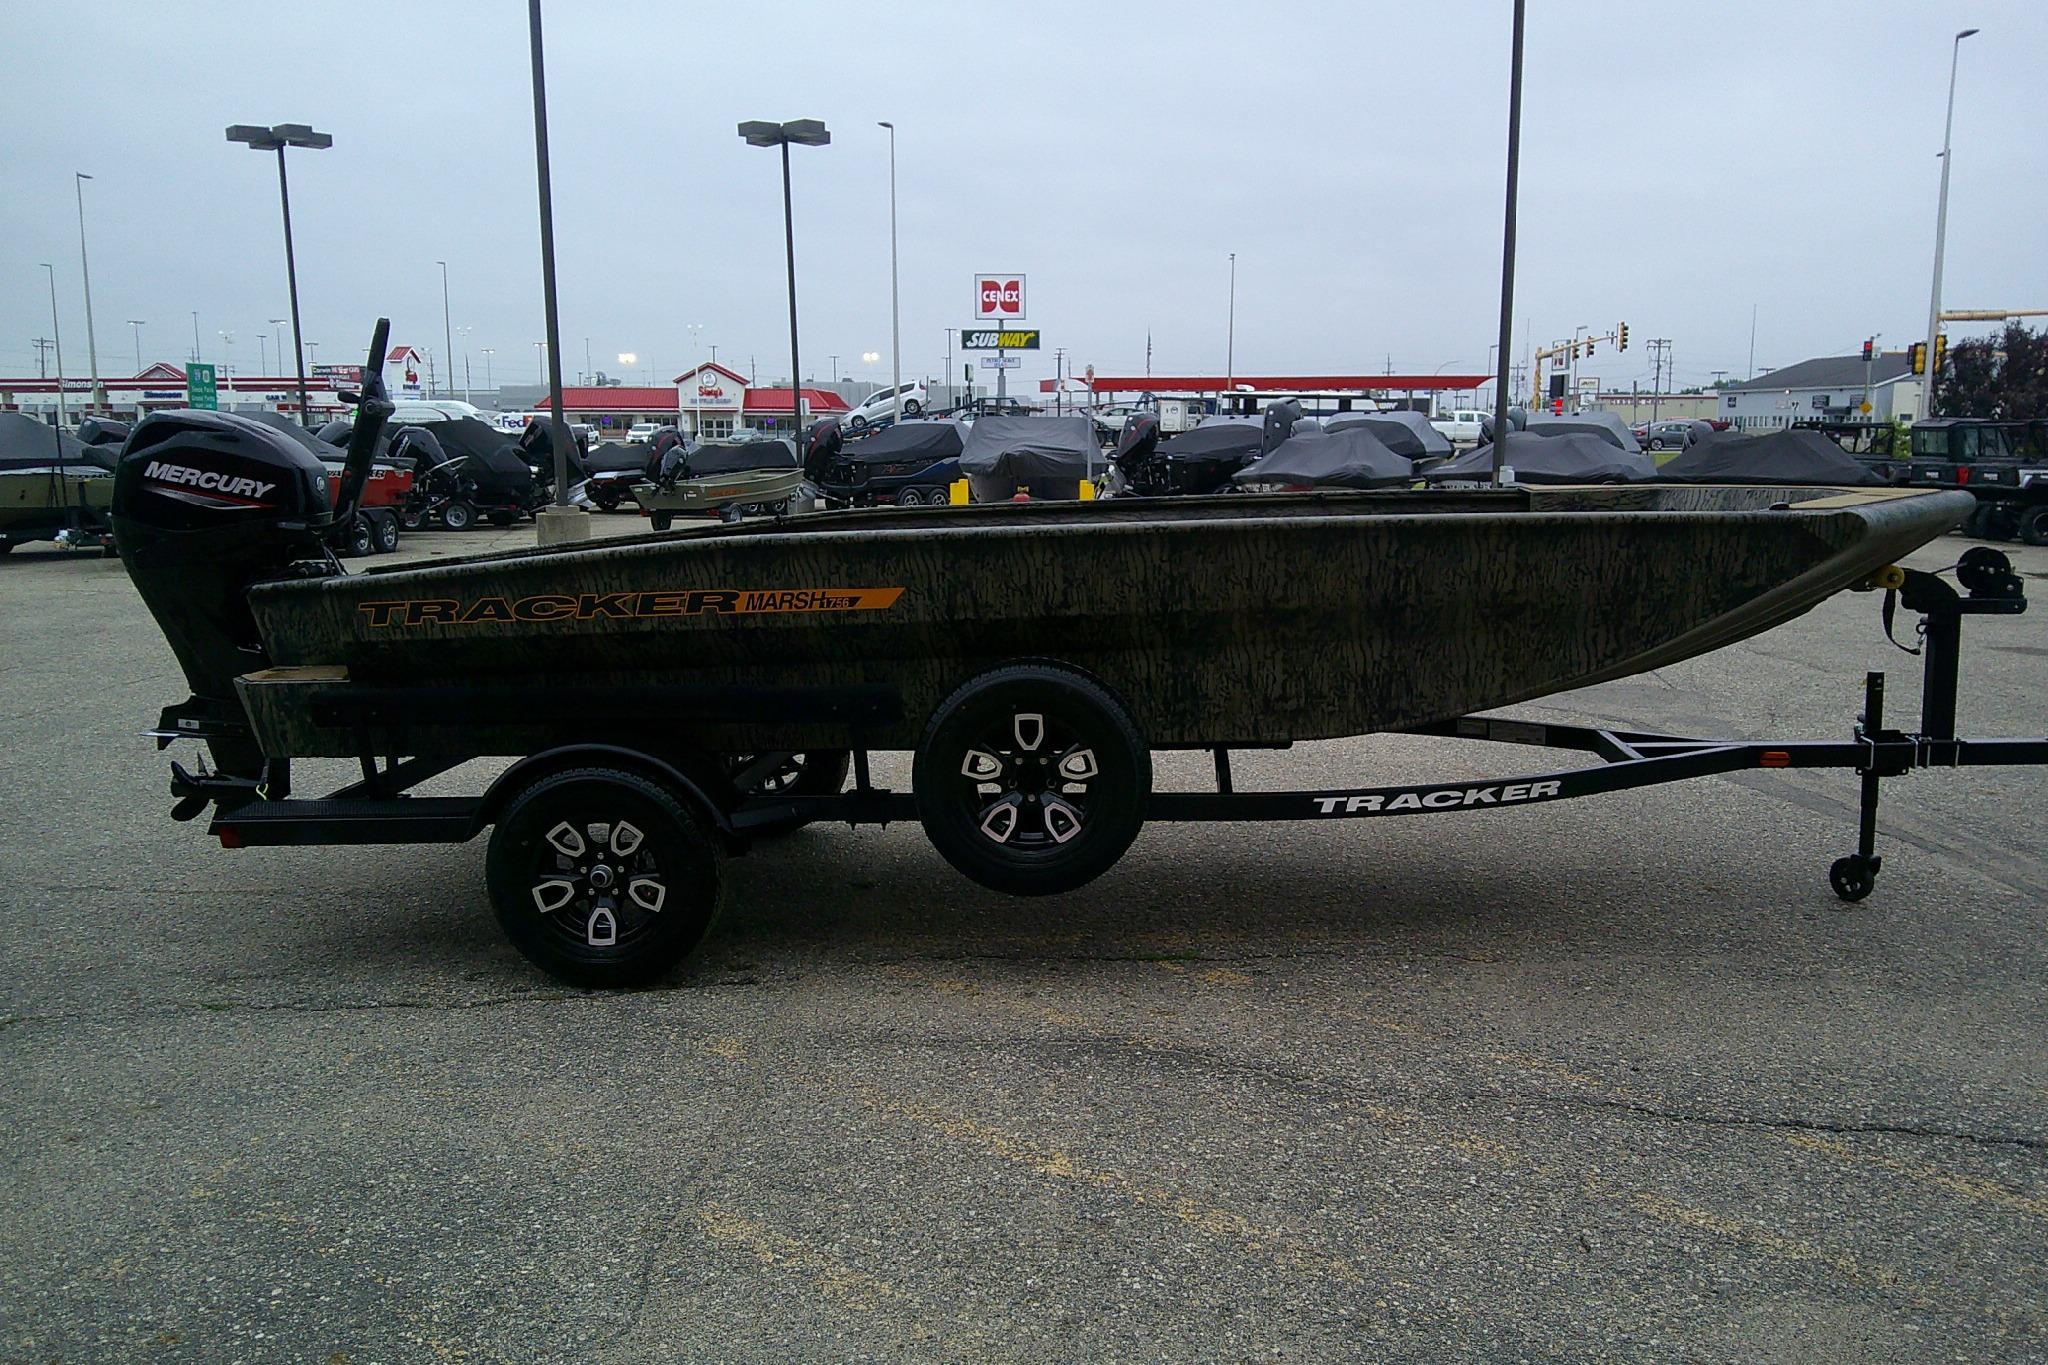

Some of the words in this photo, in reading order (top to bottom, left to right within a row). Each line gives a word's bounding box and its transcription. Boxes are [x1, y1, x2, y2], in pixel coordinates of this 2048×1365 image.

[982, 290, 1019, 302] CENEX
[966, 331, 1036, 348] SUBWAY
[59, 379, 104, 389] Simonsn
[144, 461, 276, 498] MERCURY
[358, 590, 741, 627] TRACKER
[745, 590, 826, 612] MARSH
[824, 597, 850, 609] 1756
[1313, 780, 1562, 813] TRACKER
